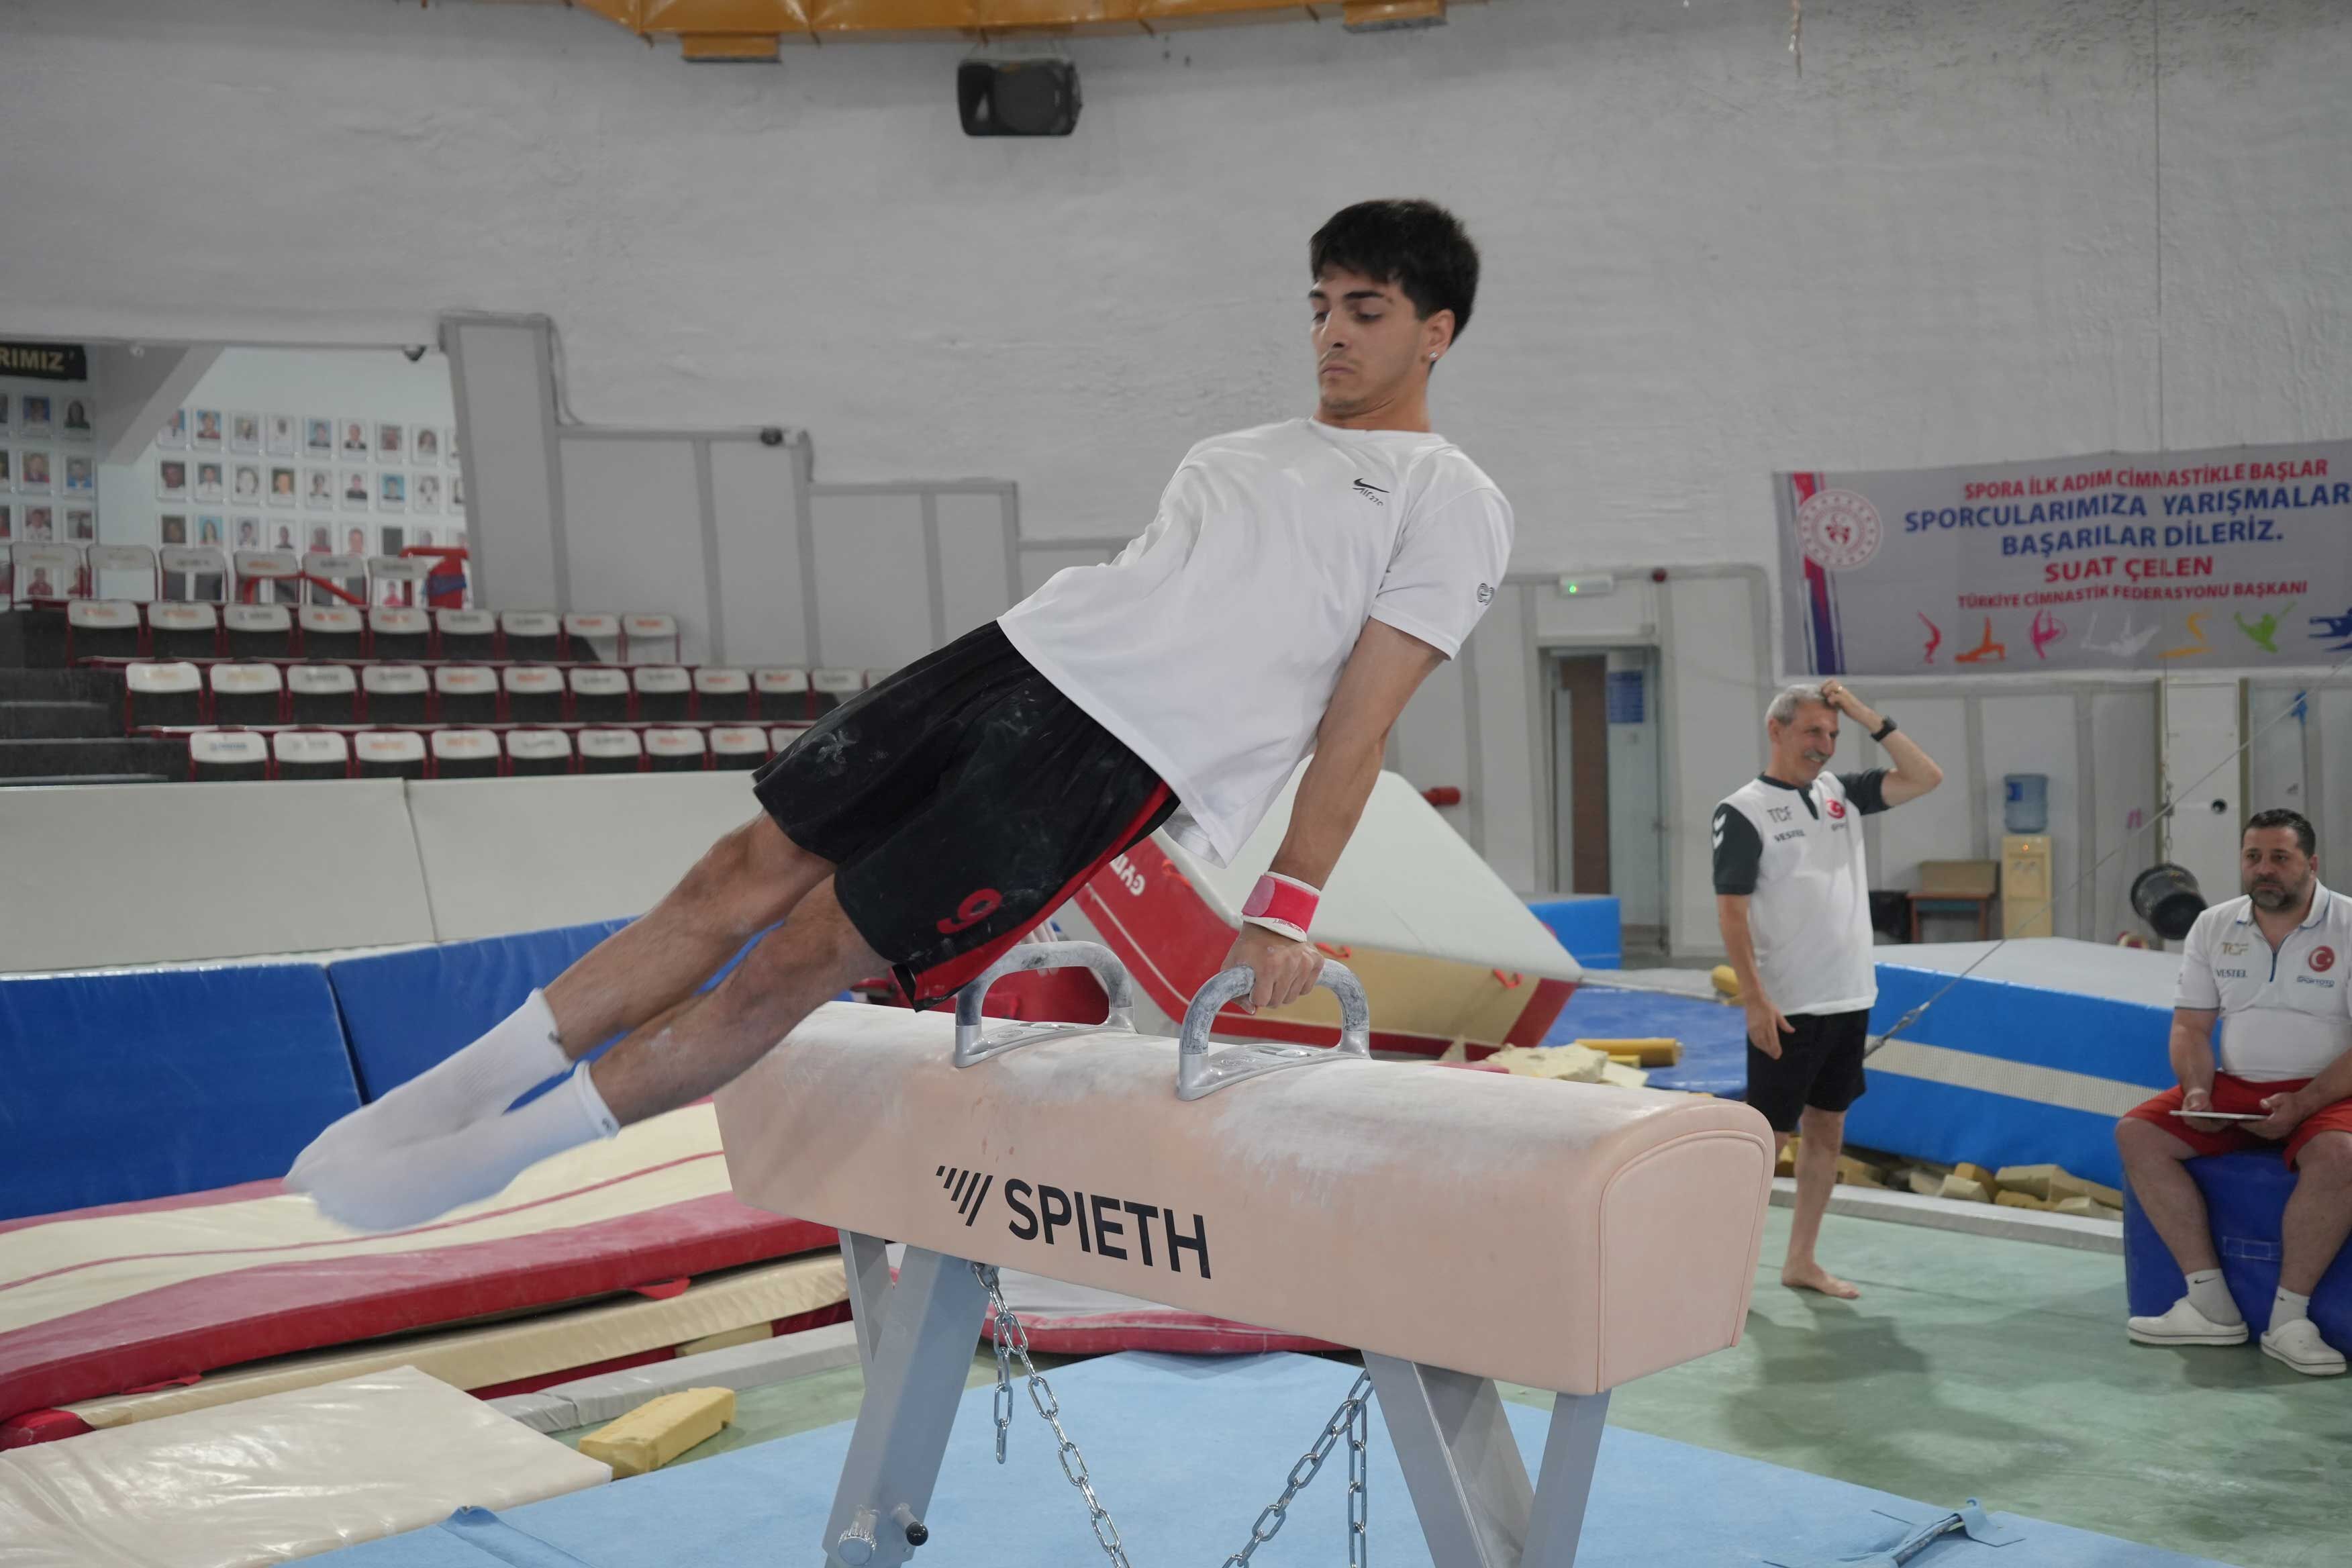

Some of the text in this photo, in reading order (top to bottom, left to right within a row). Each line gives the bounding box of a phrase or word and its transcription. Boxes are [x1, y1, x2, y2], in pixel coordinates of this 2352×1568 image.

[1965, 480, 2024, 500] SPORA
[2029, 475, 2057, 495] İLK
[2062, 469, 2112, 492] ADIM
[2250, 458, 2328, 482] BAŞLAR
[1905, 493, 2147, 532] SPORCULARIMIZA
[2162, 482, 2352, 516] YARIŞMALAR
[2002, 515, 2284, 557] BAŞARILAR DİLERİZ.
[2045, 556, 2213, 583] SUAT ÇELEN
[1958, 592, 2020, 609] TÜRKİYE
[2113, 583, 2229, 601] FEDERASYONU
[2233, 580, 2308, 598] BAŞKANI
[1004, 1178, 1211, 1279] SPIETH
